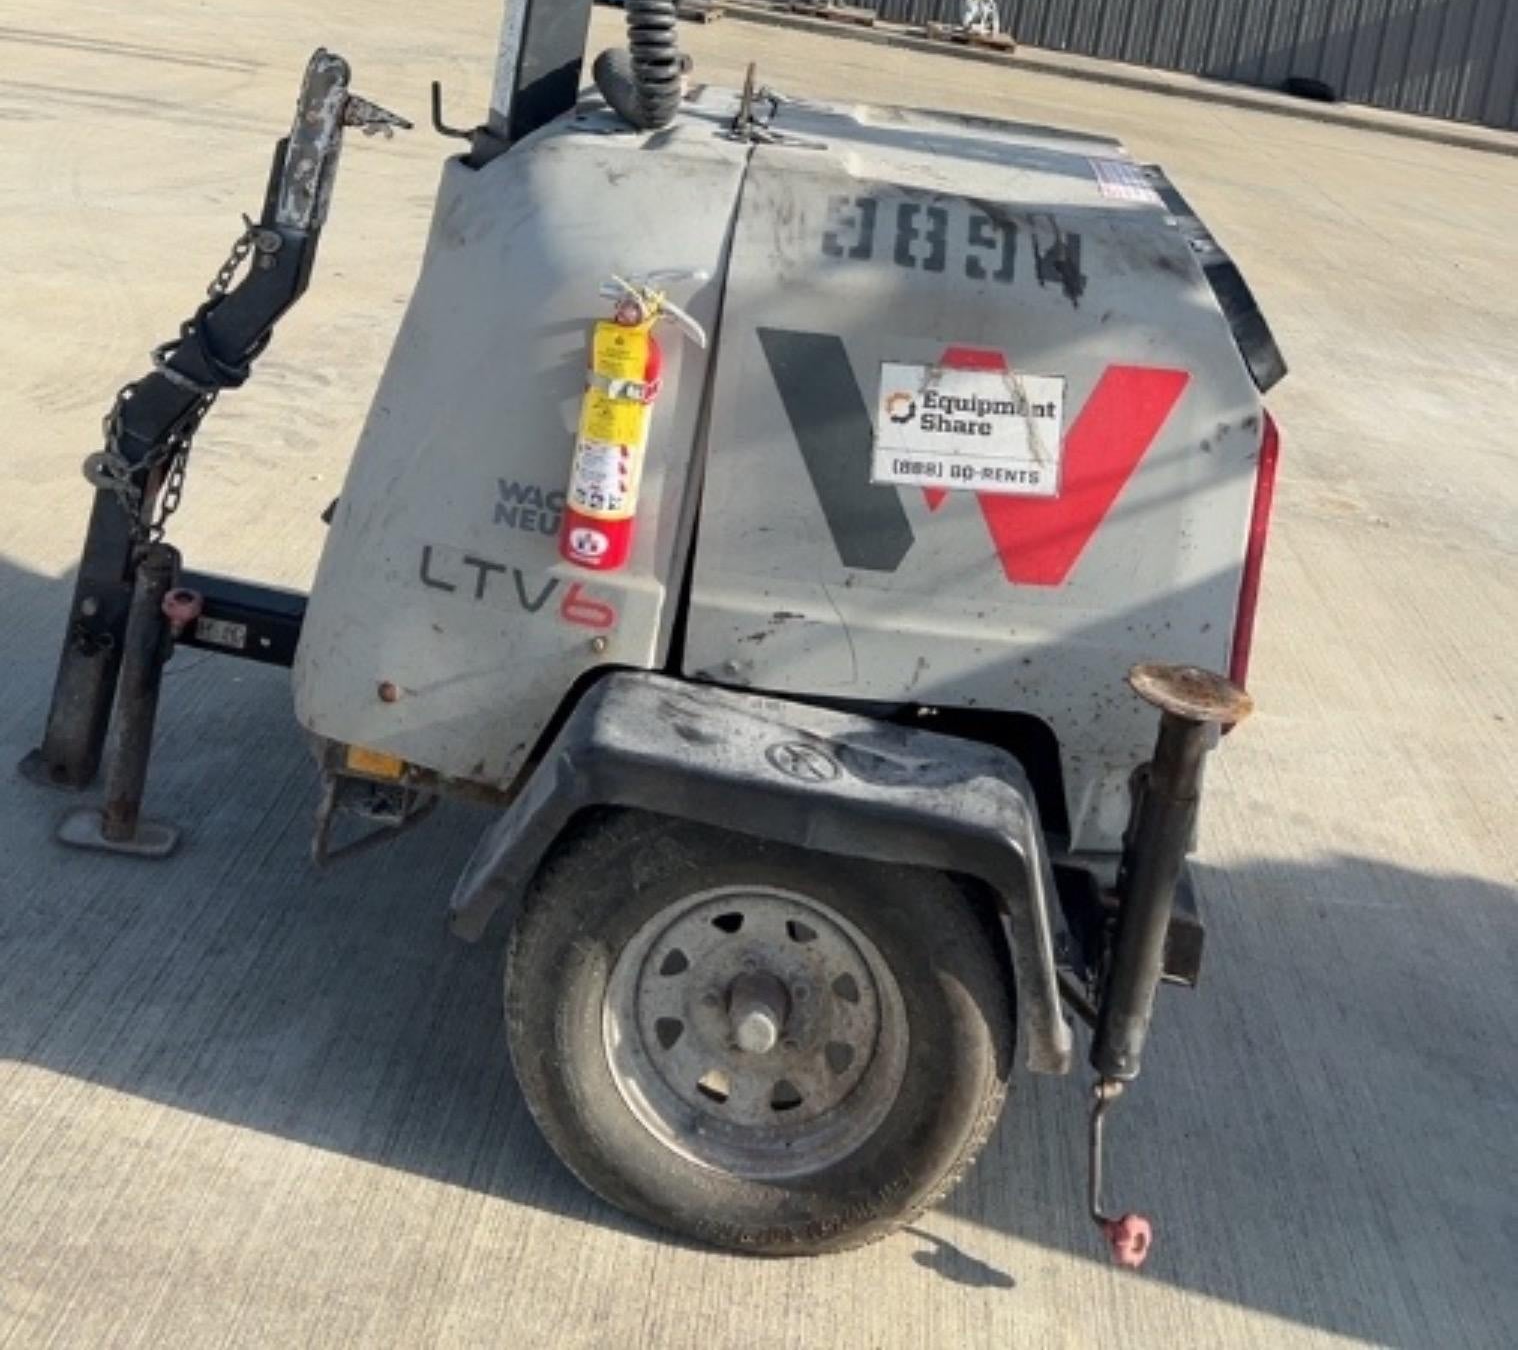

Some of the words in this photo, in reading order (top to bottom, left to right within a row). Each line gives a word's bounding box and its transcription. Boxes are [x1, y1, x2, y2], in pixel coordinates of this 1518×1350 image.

[919, 413, 992, 436] Share
[497, 477, 567, 513] WAC
[493, 503, 562, 536] NEU
[419, 544, 617, 629] LTV6
